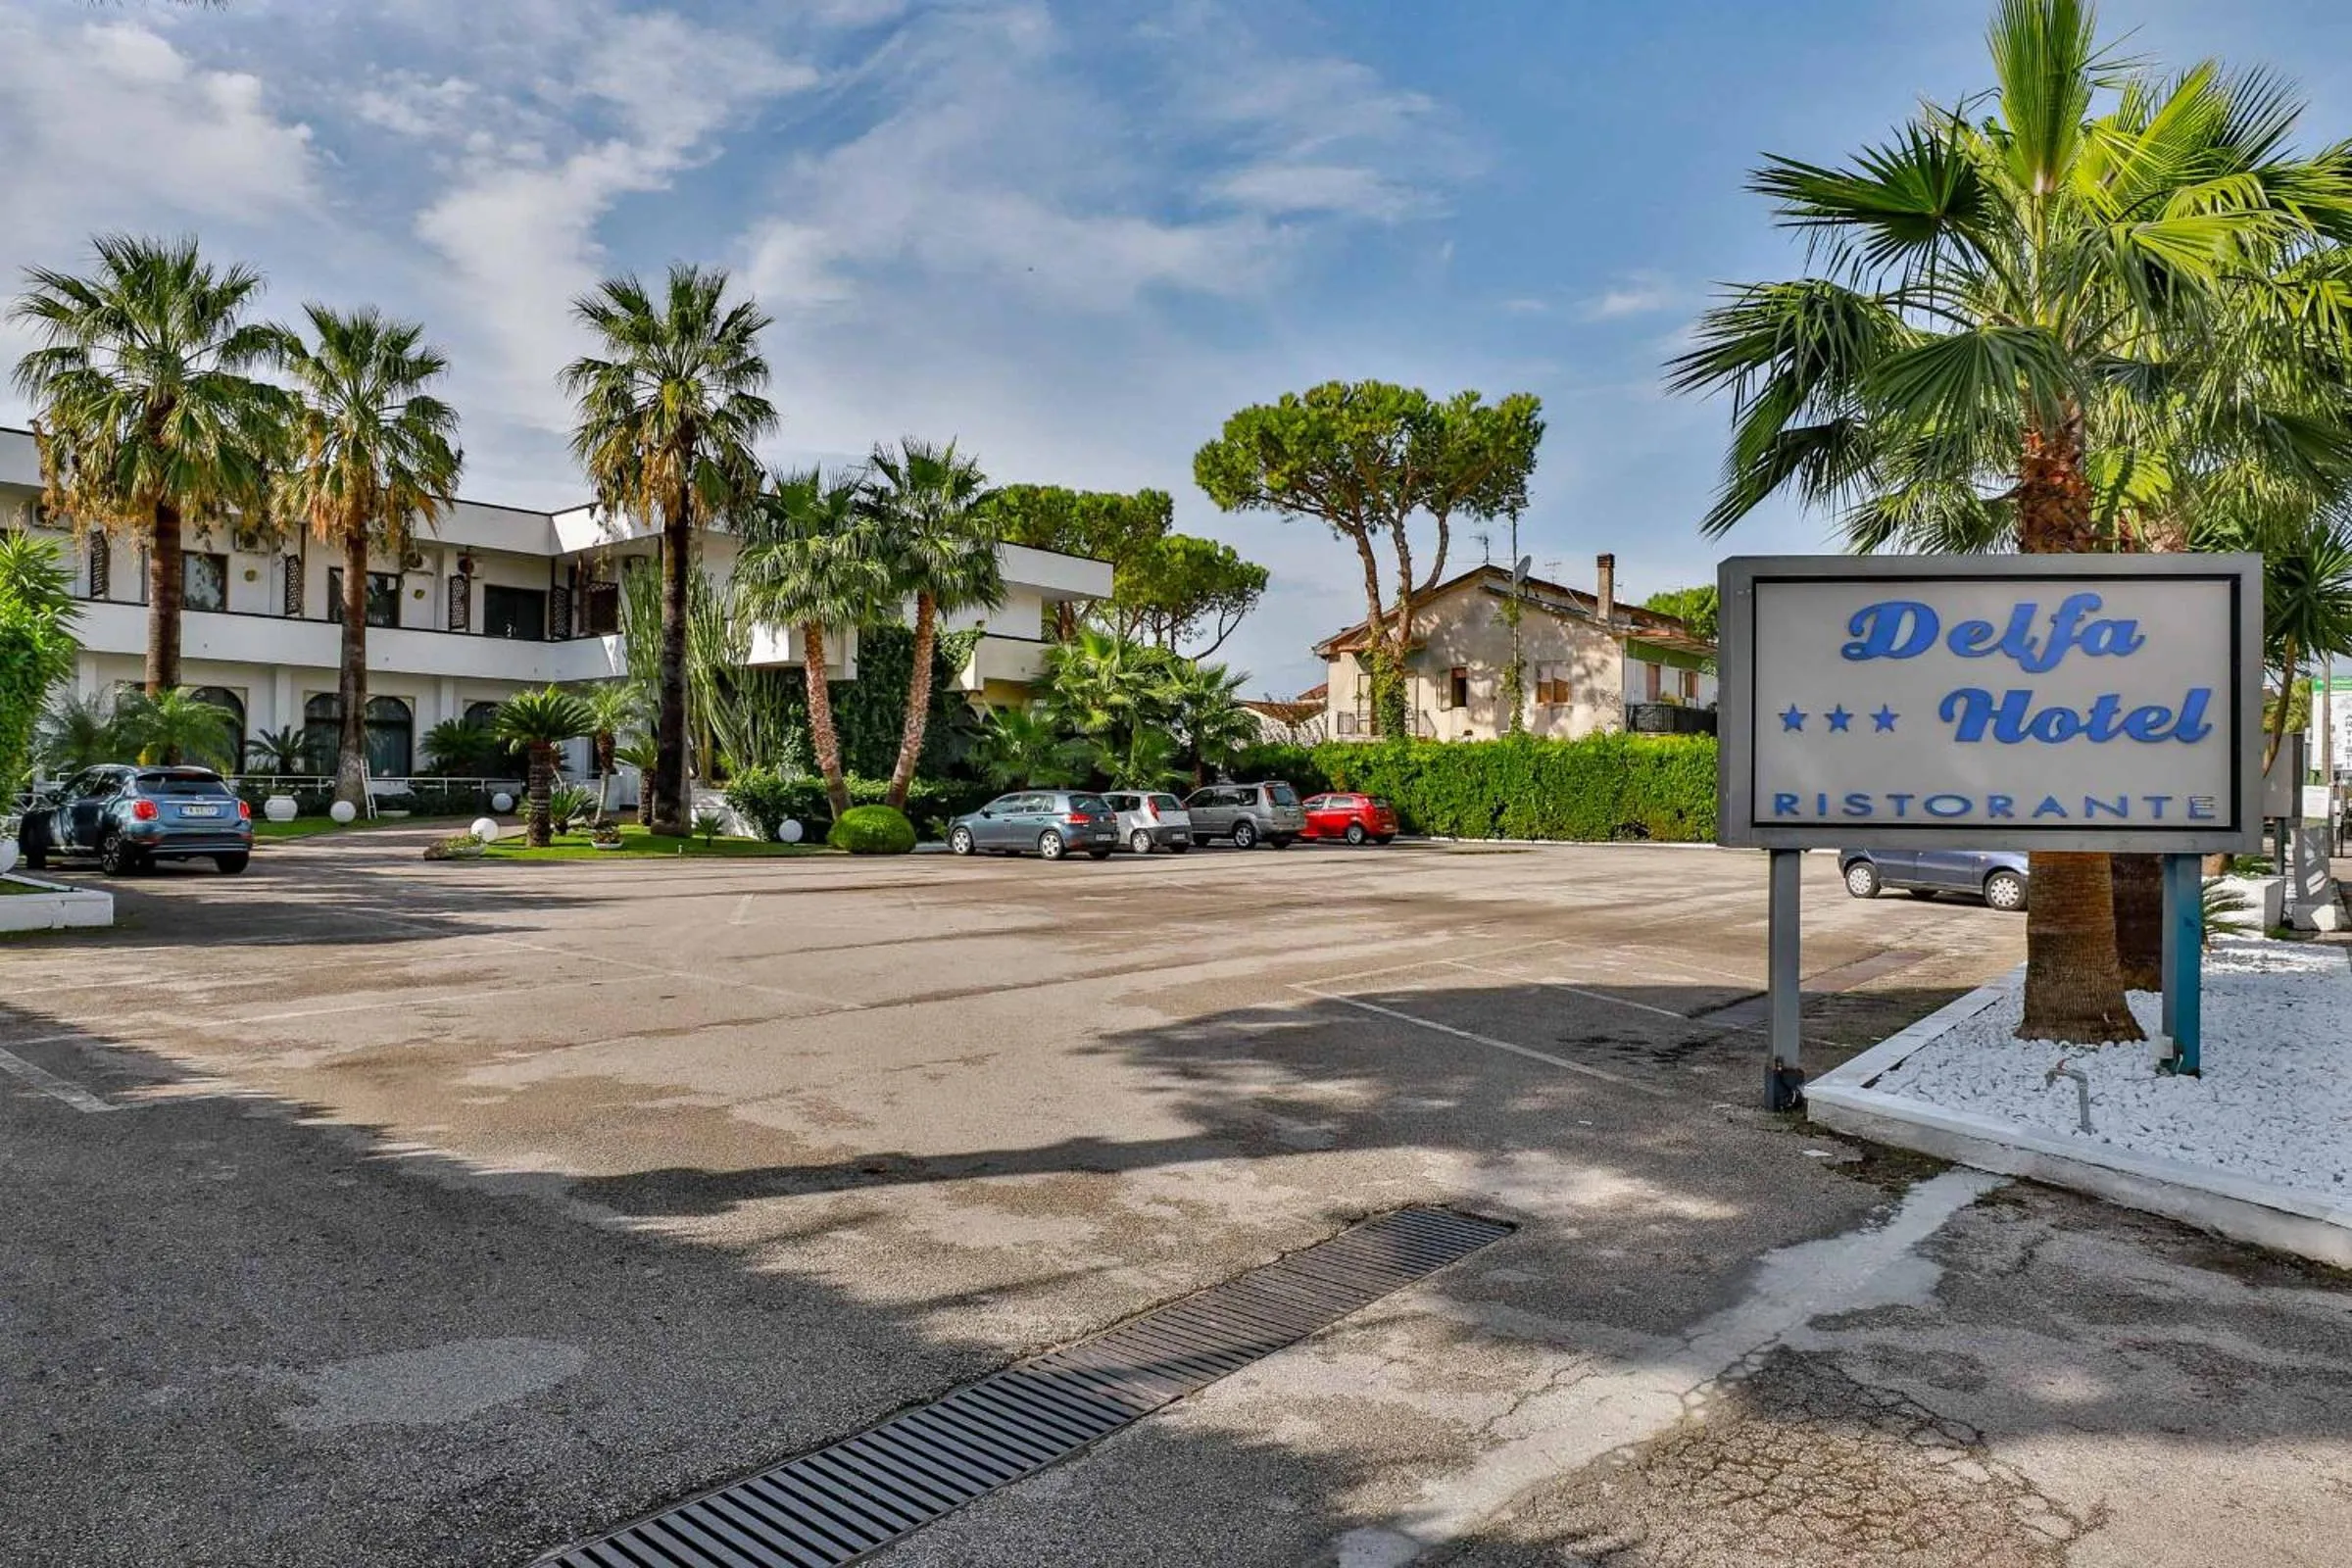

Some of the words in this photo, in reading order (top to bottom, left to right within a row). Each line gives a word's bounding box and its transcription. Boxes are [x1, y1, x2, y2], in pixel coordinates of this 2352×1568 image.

[1840, 592, 2146, 673] Delfa
[1938, 687, 2212, 745] Hotel
[1774, 792, 2216, 819] RISTORANTE
